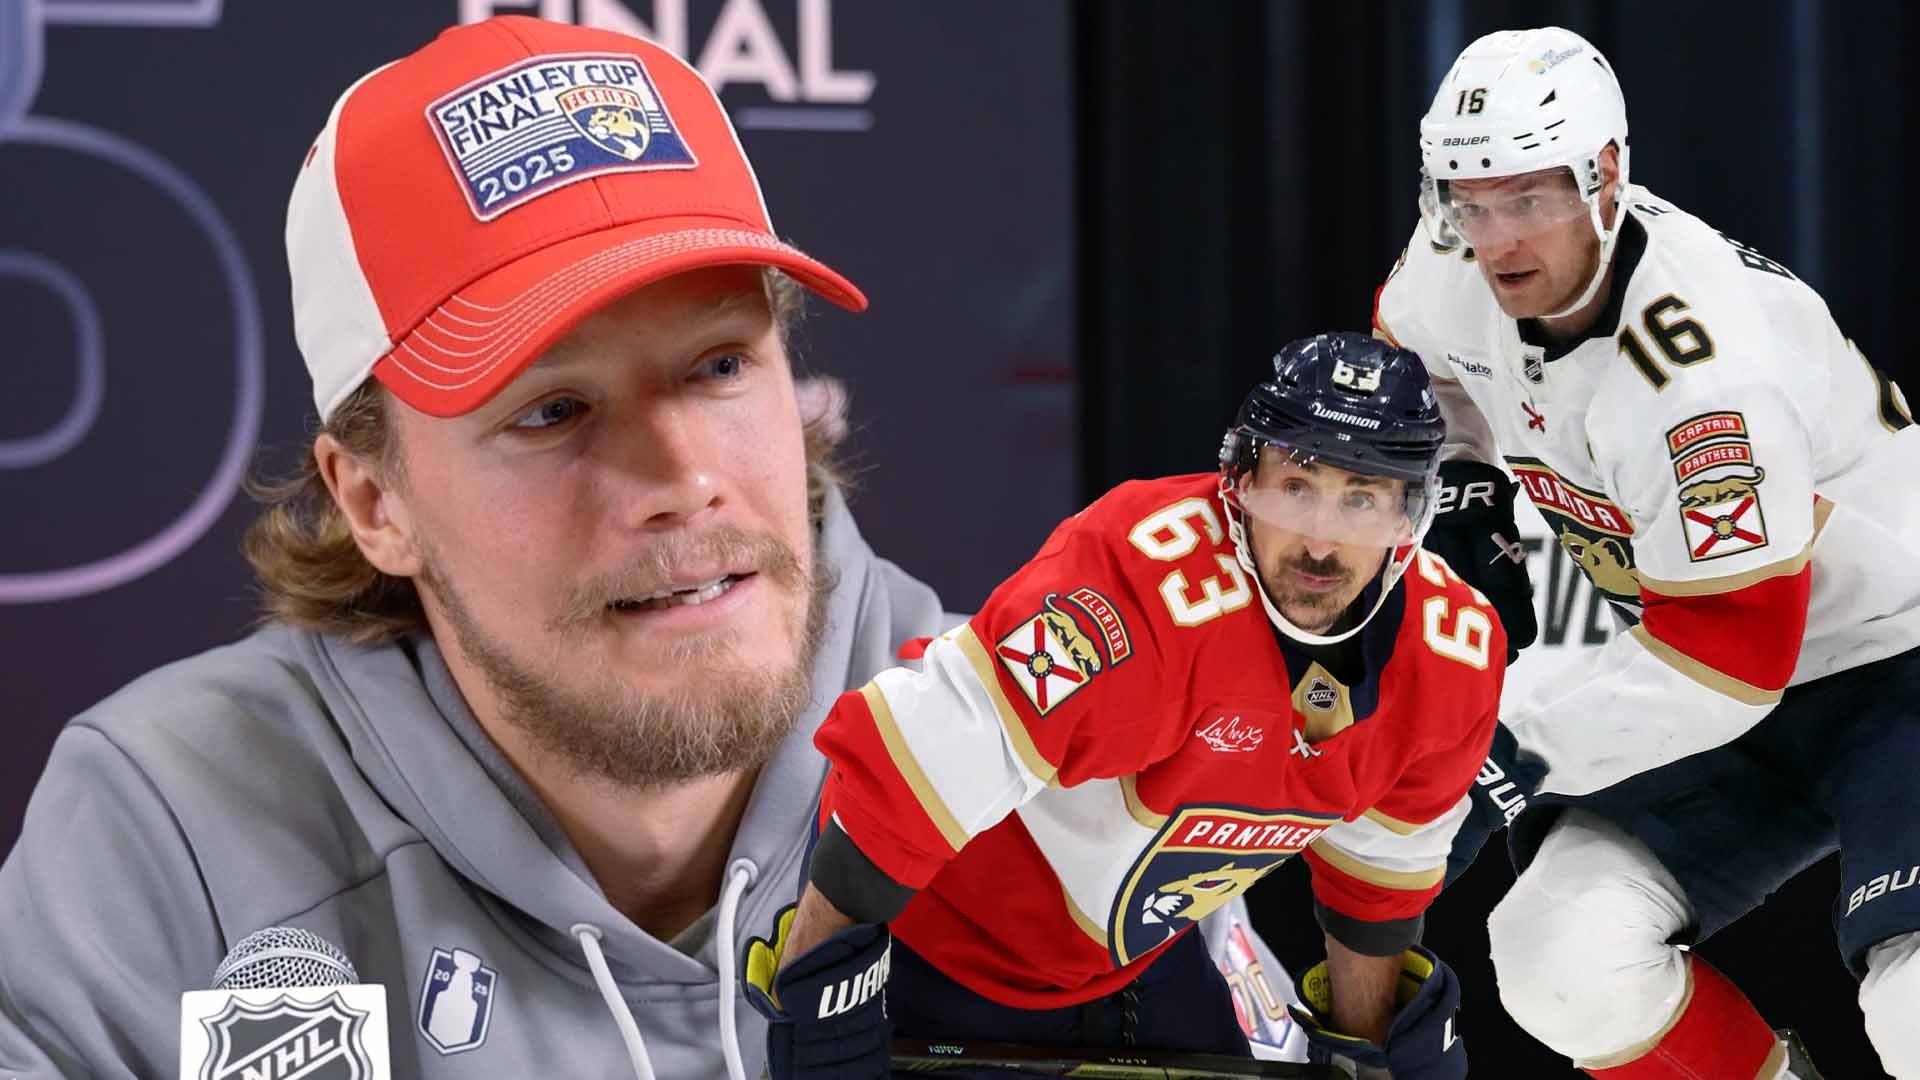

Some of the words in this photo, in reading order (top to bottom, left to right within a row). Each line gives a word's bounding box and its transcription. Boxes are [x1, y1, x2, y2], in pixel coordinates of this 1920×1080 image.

[458, 0, 877, 102] NAL
[443, 65, 576, 130] STANLEY
[584, 64, 638, 86] CUP
[1456, 88, 1488, 116] 16
[453, 97, 555, 154] FINAL
[1442, 136, 1490, 146] BAUER
[479, 146, 575, 207] 2025
[1617, 293, 1716, 392] 16
[1309, 402, 1381, 430] WARRIOR
[1677, 419, 1736, 443] CAPTAIN
[1684, 448, 1743, 473] PANTHERS
[1128, 497, 1253, 627] 63
[1080, 594, 1124, 652] FLORIDA
[1310, 691, 1333, 701] NHL
[1183, 820, 1325, 848] PANTHER
[1844, 866, 1920, 917] BAU
[434, 969, 450, 982] 20
[239, 1027, 334, 1080] NHL
